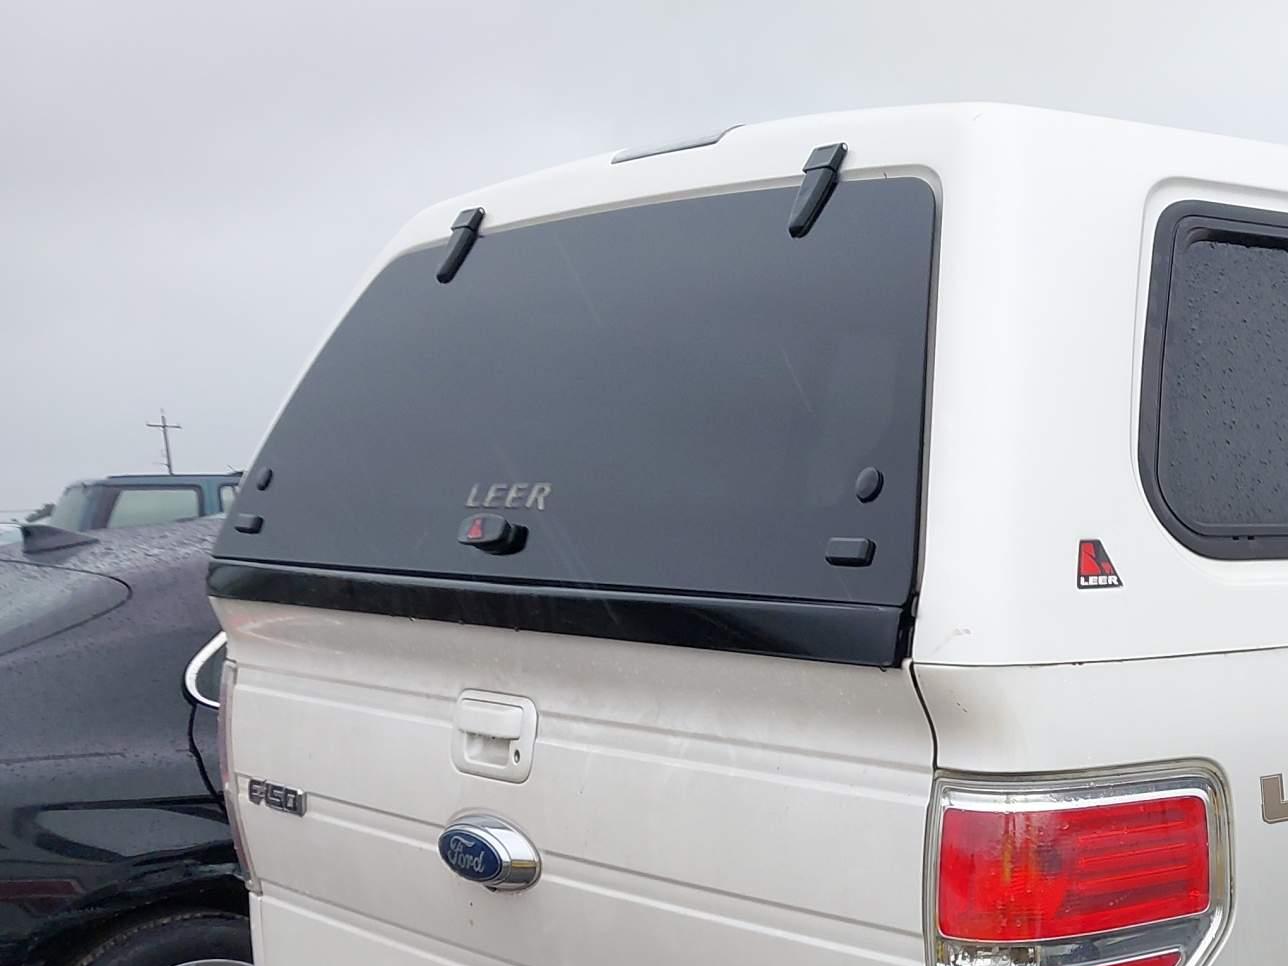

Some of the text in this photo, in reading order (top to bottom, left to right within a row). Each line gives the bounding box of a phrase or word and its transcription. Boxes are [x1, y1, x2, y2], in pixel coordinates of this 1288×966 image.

[465, 482, 552, 510] LEER
[1080, 575, 1119, 586] LEER
[447, 835, 485, 873] Ford
